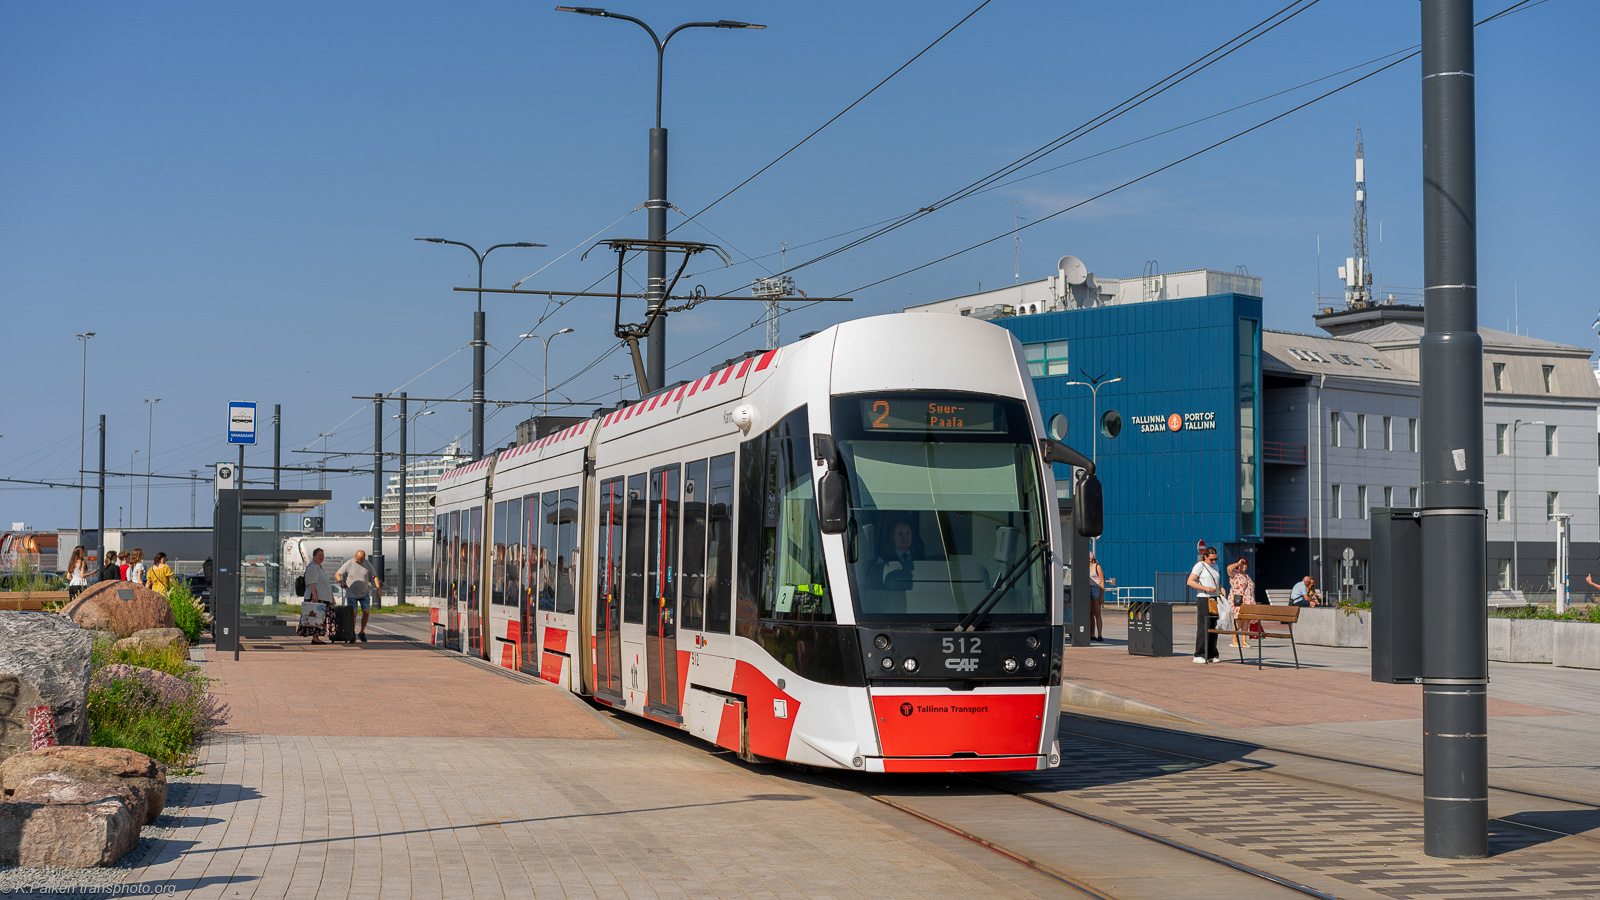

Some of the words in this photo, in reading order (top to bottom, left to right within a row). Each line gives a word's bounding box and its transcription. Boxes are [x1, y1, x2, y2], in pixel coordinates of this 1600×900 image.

[928, 403, 965, 413] Suur-
[872, 400, 890, 428] 2
[1184, 412, 1204, 421] PORT
[1204, 412, 1215, 420] OF
[930, 416, 963, 427] Paala
[1131, 415, 1166, 424] TALLINNA
[1141, 424, 1166, 433] SADAM
[1184, 421, 1216, 430] TALLINN
[303, 517, 311, 528] C
[316, 518, 320, 528] C
[781, 592, 787, 604] 2
[942, 637, 982, 654] 512
[691, 652, 700, 666] 512
[944, 658, 979, 672] CAF
[917, 705, 949, 713] Tallinna
[950, 705, 989, 714] Transport
